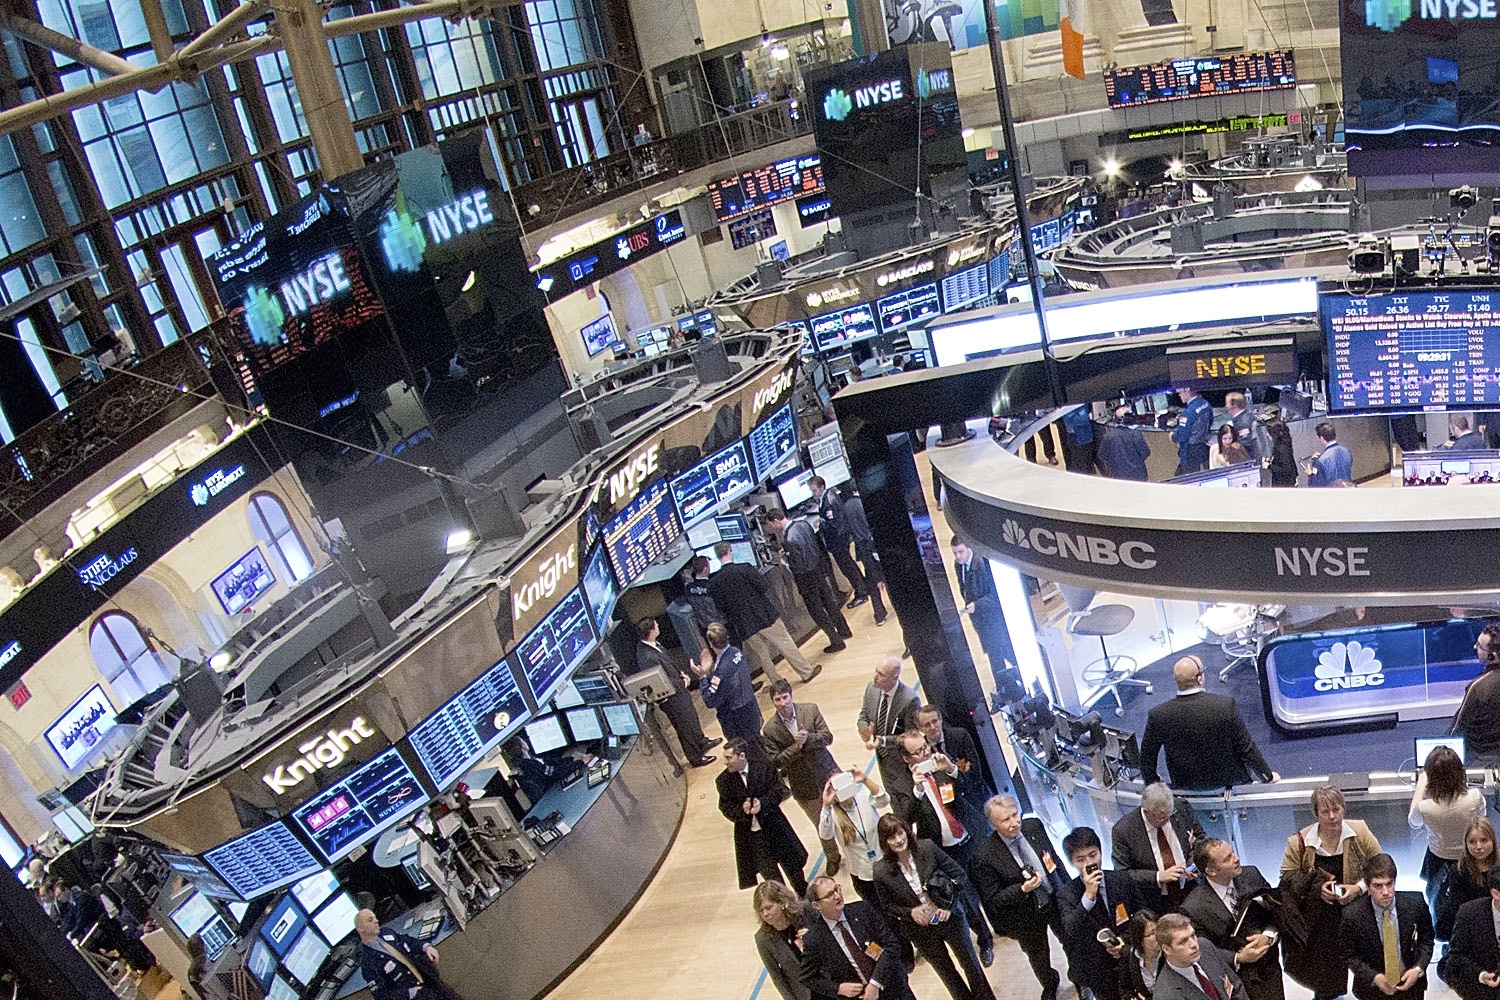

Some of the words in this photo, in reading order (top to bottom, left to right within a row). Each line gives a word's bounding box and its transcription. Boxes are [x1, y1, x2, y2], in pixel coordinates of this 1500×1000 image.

[1420, 0, 1497, 19] NYSE
[929, 69, 949, 91] NYSE
[855, 79, 903, 109] NYSE
[427, 190, 494, 244] NYSE
[628, 231, 649, 252] UBS
[281, 250, 351, 317] NYSE
[888, 260, 934, 283] BARCLAYS
[1345, 307, 1368, 316] 50.15
[1386, 306, 1409, 314] 26.36
[1426, 304, 1449, 312] 29.77
[1467, 304, 1490, 312] 51.40
[1195, 354, 1266, 379] NYSE
[753, 368, 794, 414] Knight
[205, 469, 225, 488] NYSE
[208, 465, 246, 496] EURONEXT
[610, 443, 659, 505] NYSE
[1029, 527, 1157, 570] CNBC
[1275, 547, 1370, 577] NYSE
[79, 553, 113, 585] STIFEL
[89, 547, 138, 590] NICOLAUS
[513, 542, 576, 620] Knight
[1313, 672, 1385, 692] CNBC
[262, 716, 375, 795] Knight
[378, 799, 405, 818] NUVEEN
